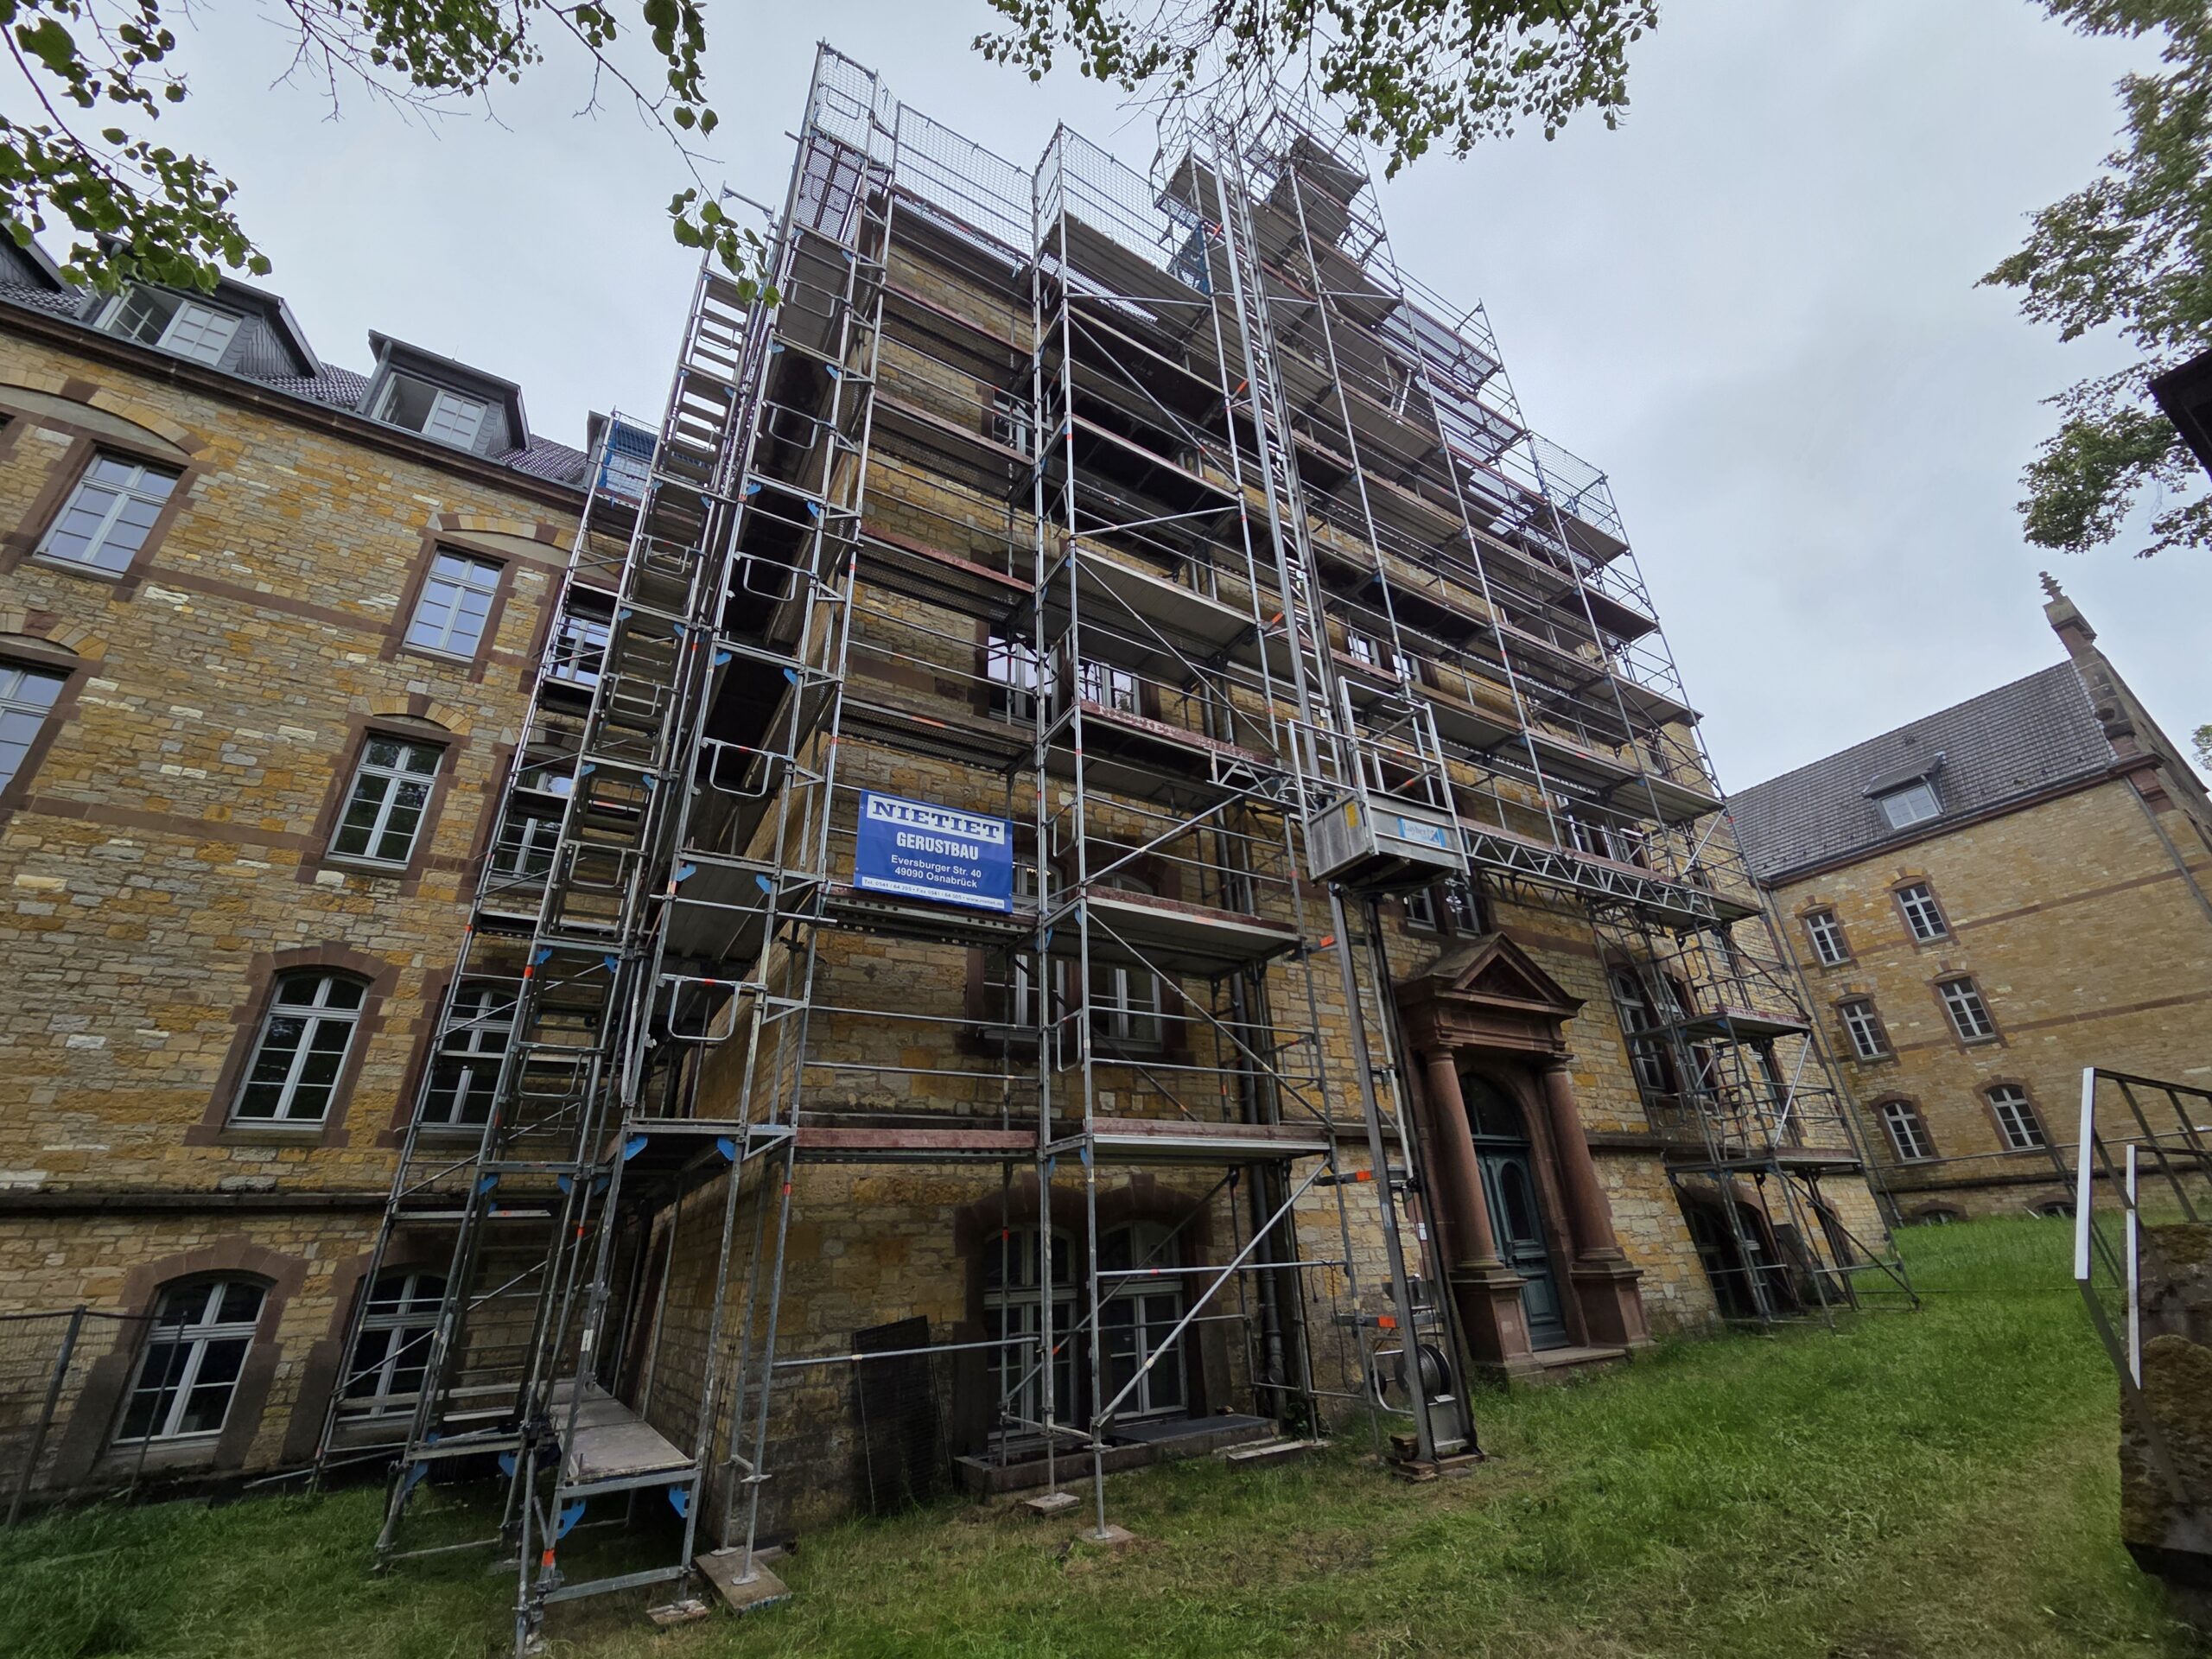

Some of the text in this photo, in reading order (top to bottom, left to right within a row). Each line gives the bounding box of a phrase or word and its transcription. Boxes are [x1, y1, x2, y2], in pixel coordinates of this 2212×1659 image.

[873, 800, 1000, 839] NIETIET
[891, 854, 982, 878] Eversburger Str. 40
[894, 866, 978, 888] 49090 Osnabrück
